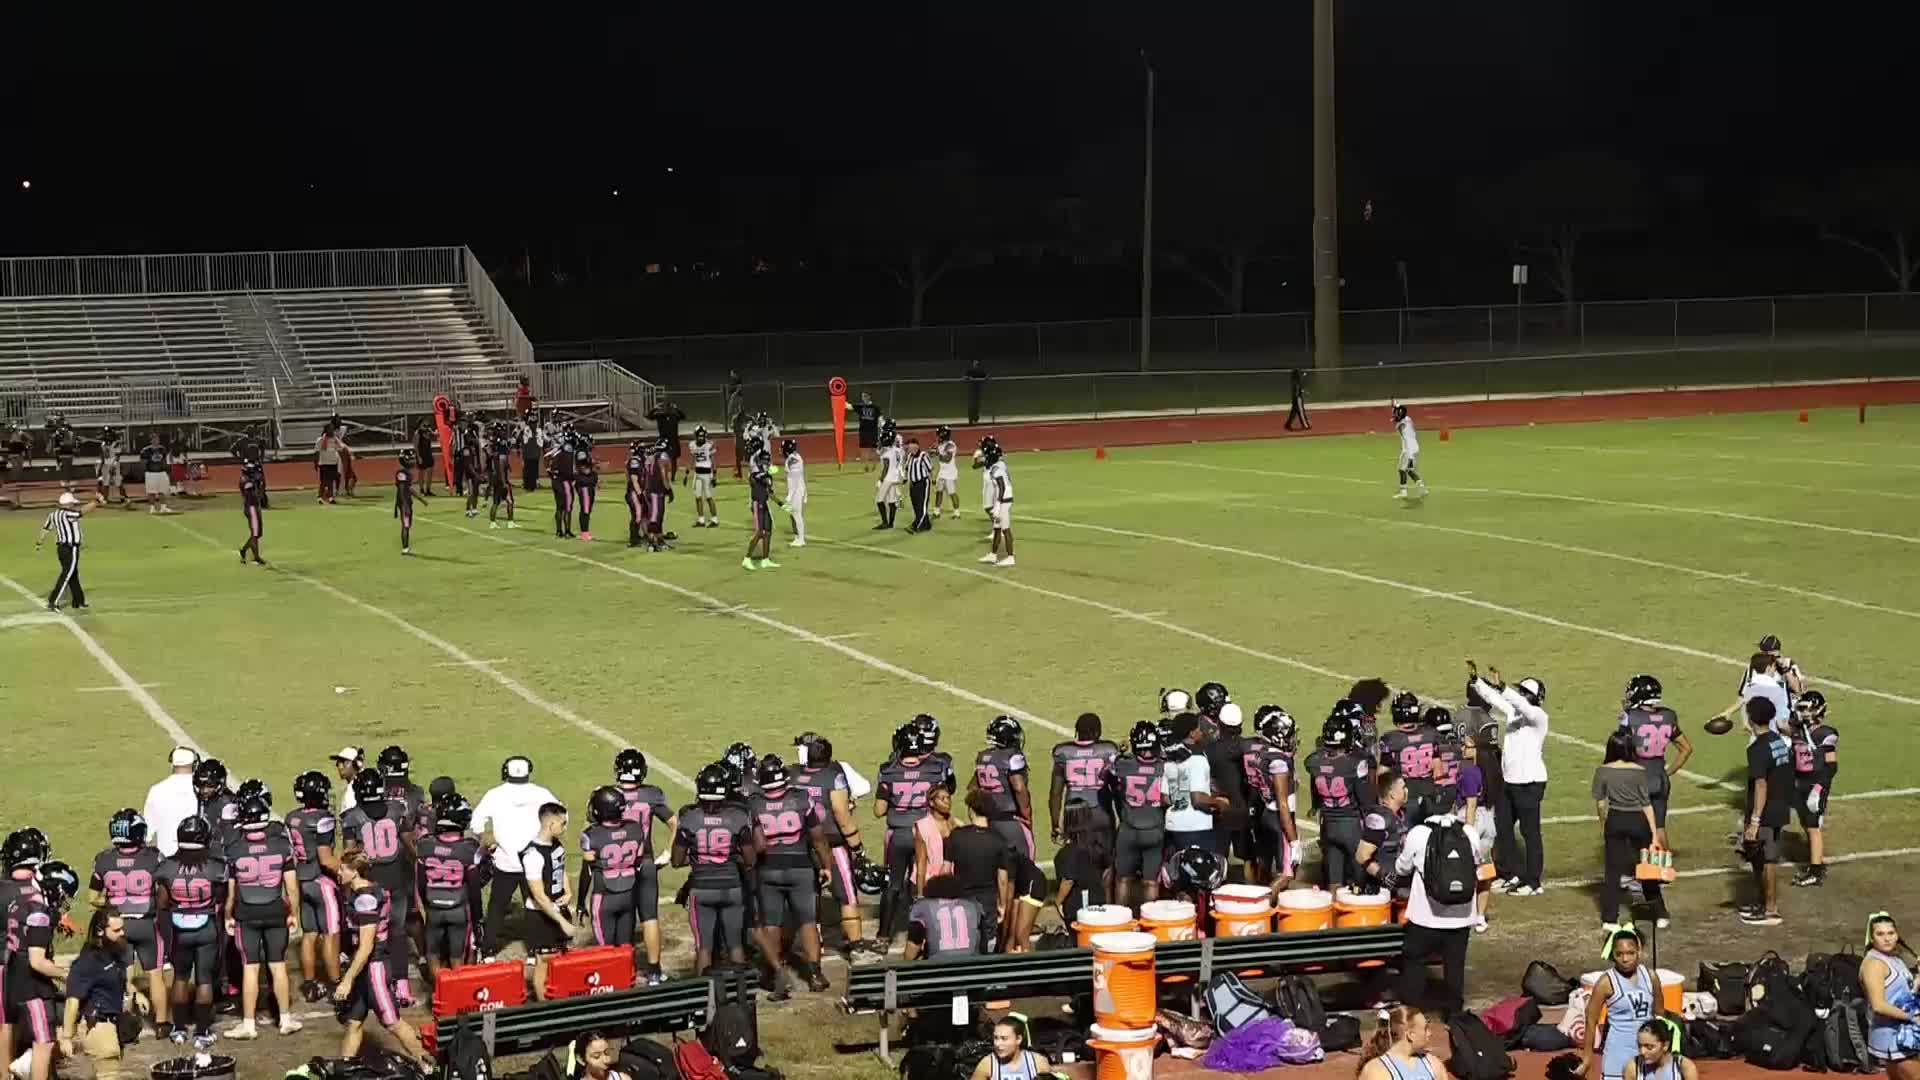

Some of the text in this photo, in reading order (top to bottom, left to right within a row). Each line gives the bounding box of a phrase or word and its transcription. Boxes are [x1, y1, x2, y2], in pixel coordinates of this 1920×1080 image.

[892, 781, 931, 812] 72
[360, 818, 398, 860] 10
[936, 905, 970, 951] 11
[1626, 991, 1650, 1019] WB
